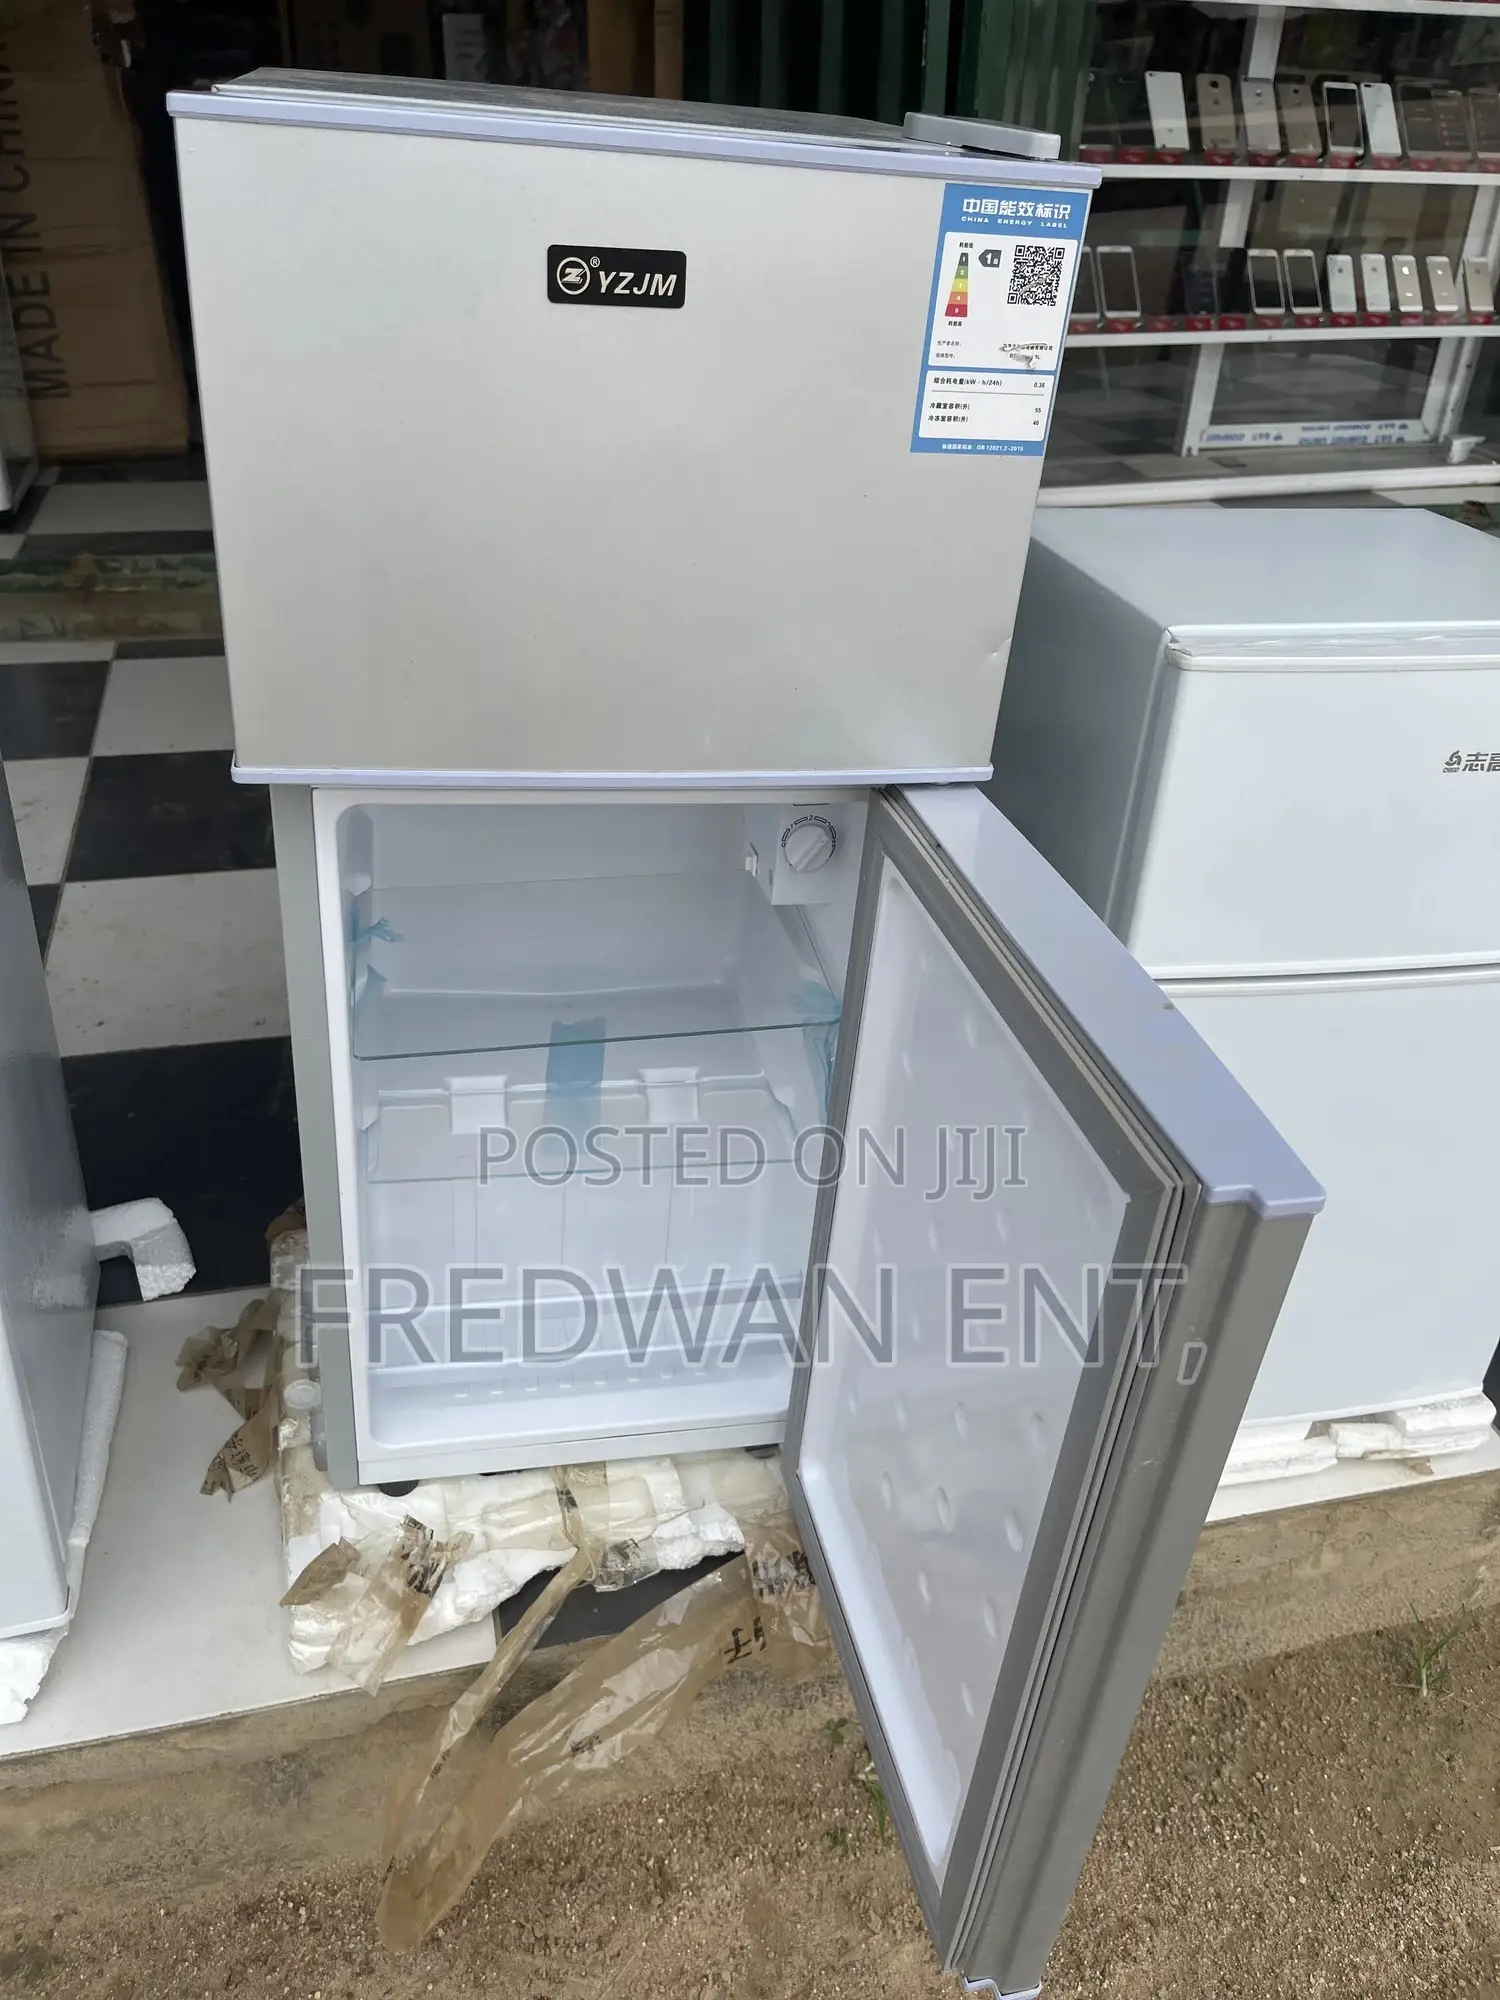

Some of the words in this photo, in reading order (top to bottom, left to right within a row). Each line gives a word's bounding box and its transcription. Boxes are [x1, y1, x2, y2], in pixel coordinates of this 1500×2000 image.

[962, 198, 1071, 219] 中国能效标识
[997, 218, 1033, 226] ENERGY
[599, 271, 677, 296] YZJM
[5, 271, 71, 399] MADE
